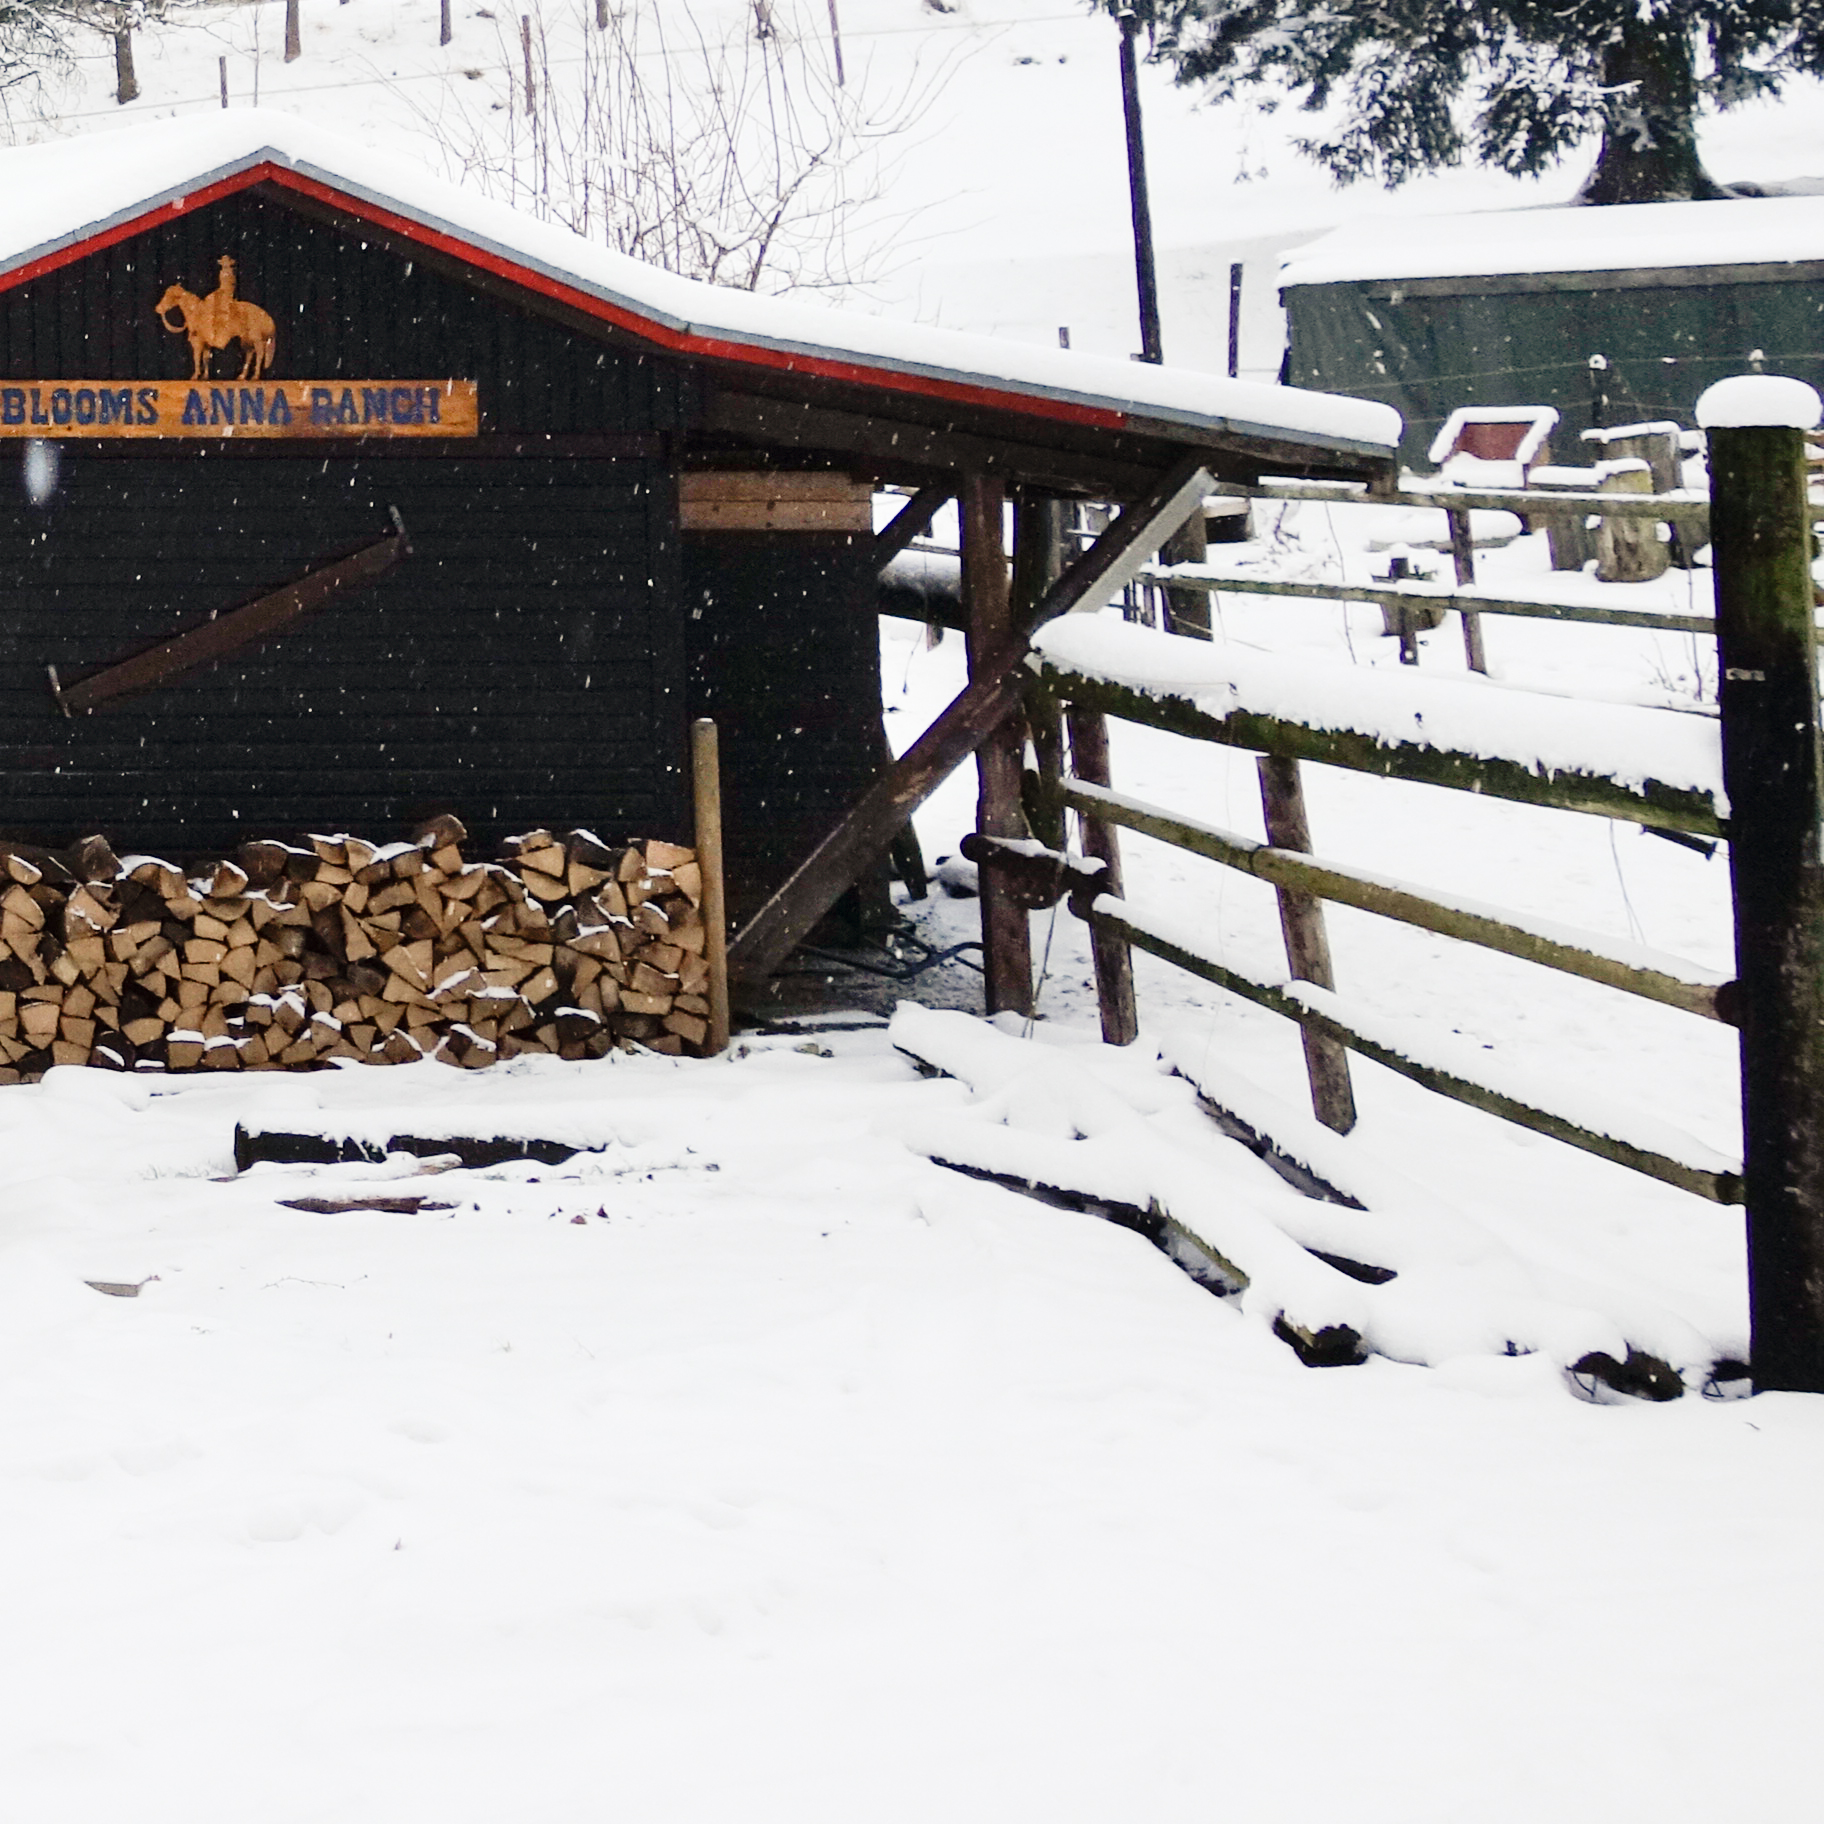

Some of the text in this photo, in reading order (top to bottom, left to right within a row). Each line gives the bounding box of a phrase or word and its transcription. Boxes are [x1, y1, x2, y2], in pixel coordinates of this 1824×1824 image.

[1, 386, 441, 425] BLOOMS ANNA RANCH
